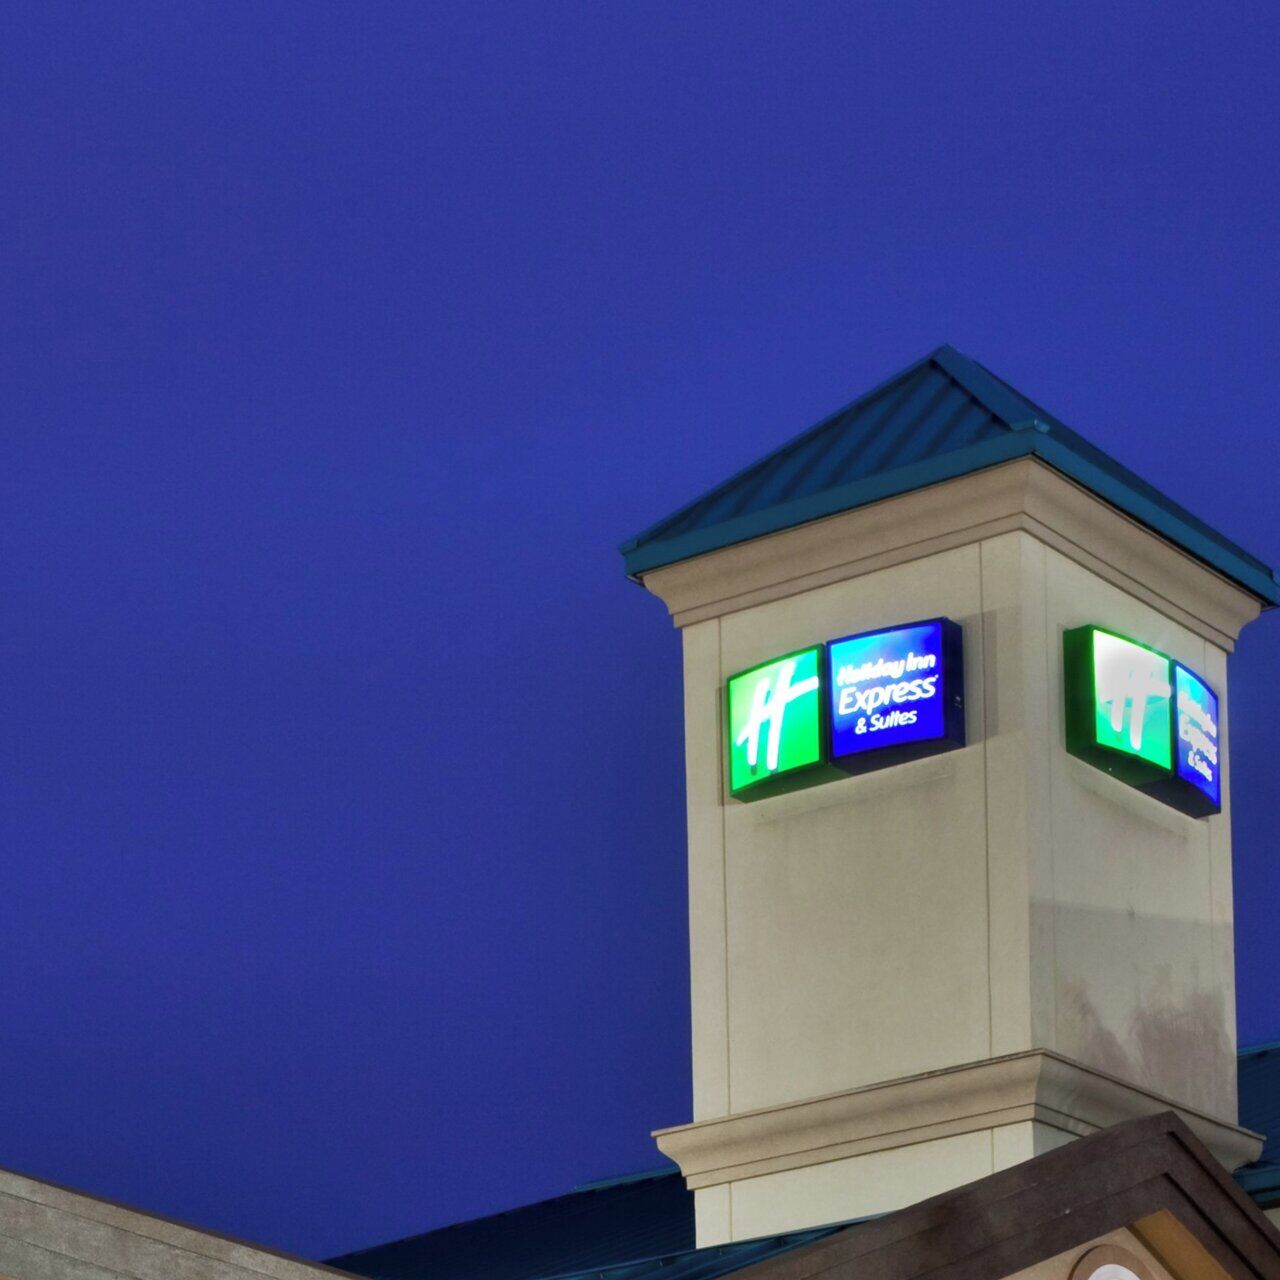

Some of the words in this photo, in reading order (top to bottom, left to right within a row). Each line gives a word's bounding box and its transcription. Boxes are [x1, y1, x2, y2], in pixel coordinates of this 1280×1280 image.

[906, 652, 936, 671] Inn
[839, 676, 937, 715] Express
[855, 717, 867, 735] &
[869, 710, 917, 732] Suites
